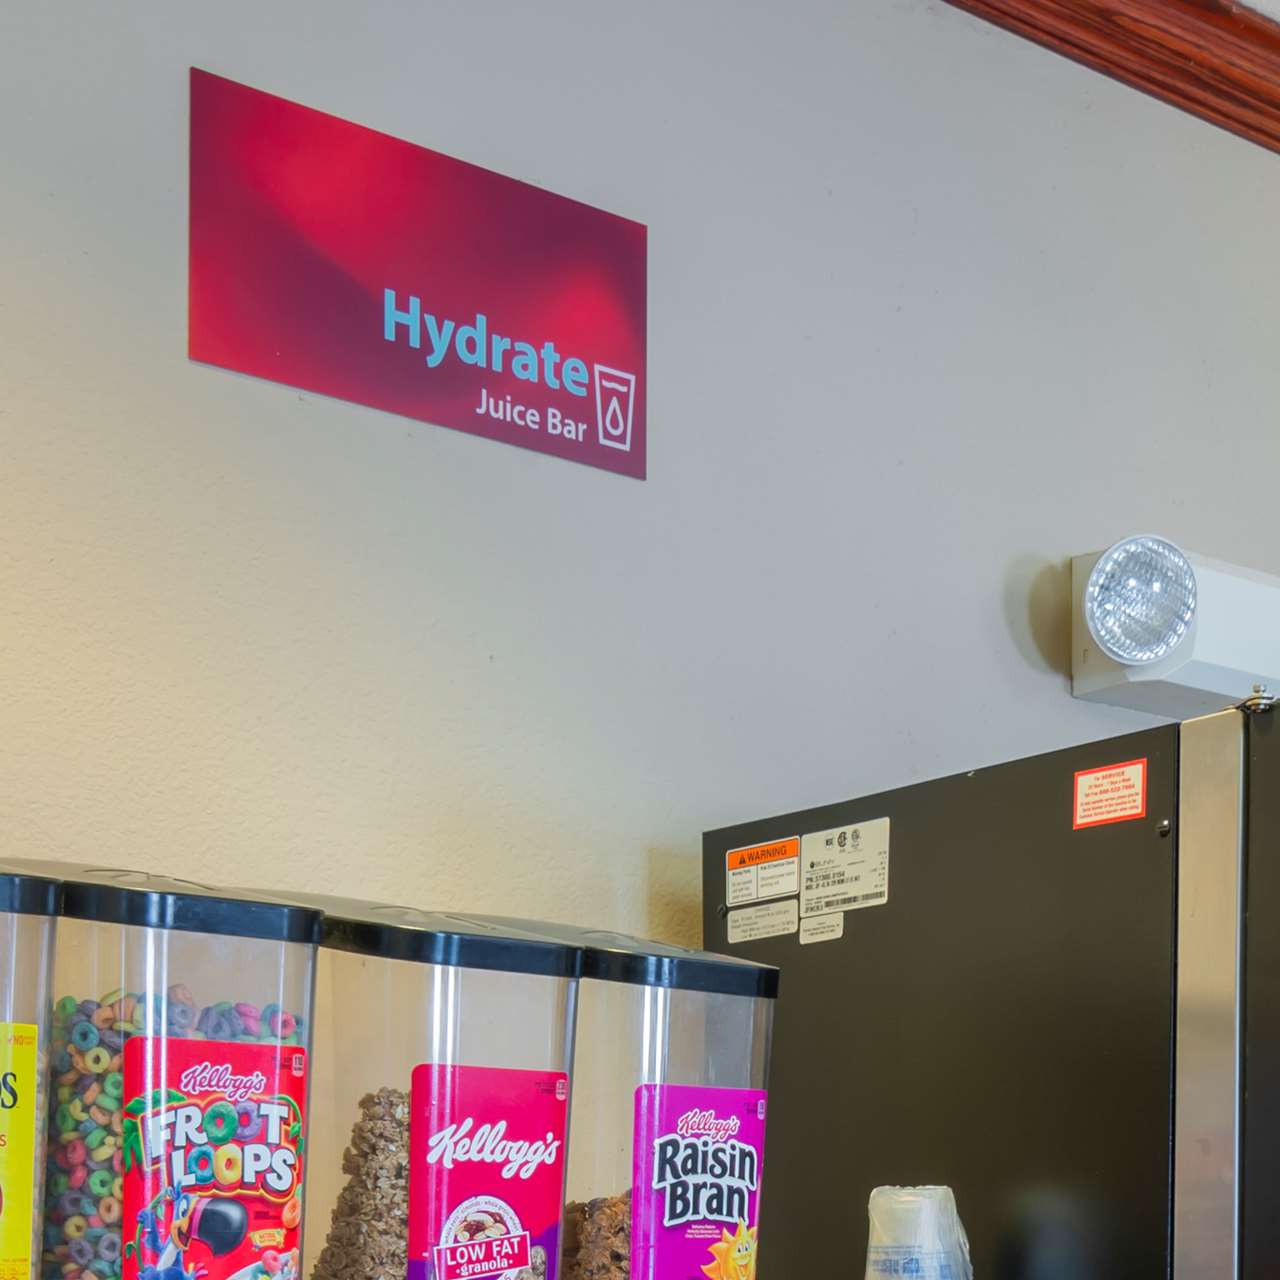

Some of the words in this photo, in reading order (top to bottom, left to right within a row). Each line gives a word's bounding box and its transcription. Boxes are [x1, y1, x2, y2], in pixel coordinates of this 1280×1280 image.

[384, 288, 589, 397] Hydrate
[476, 388, 540, 430] Juice
[547, 407, 587, 442] Bar
[747, 845, 787, 863] WARNING
[181, 1062, 265, 1100] Kellogg's
[147, 1101, 289, 1158] FROOT
[427, 1118, 560, 1179] Kellogg's
[677, 1109, 740, 1141] Kellogg's
[172, 1142, 296, 1191] LOOPS
[657, 1138, 755, 1187] Raisin
[668, 1179, 746, 1222] Bran
[446, 1243, 485, 1265] LOW
[492, 1238, 520, 1257] FAT
